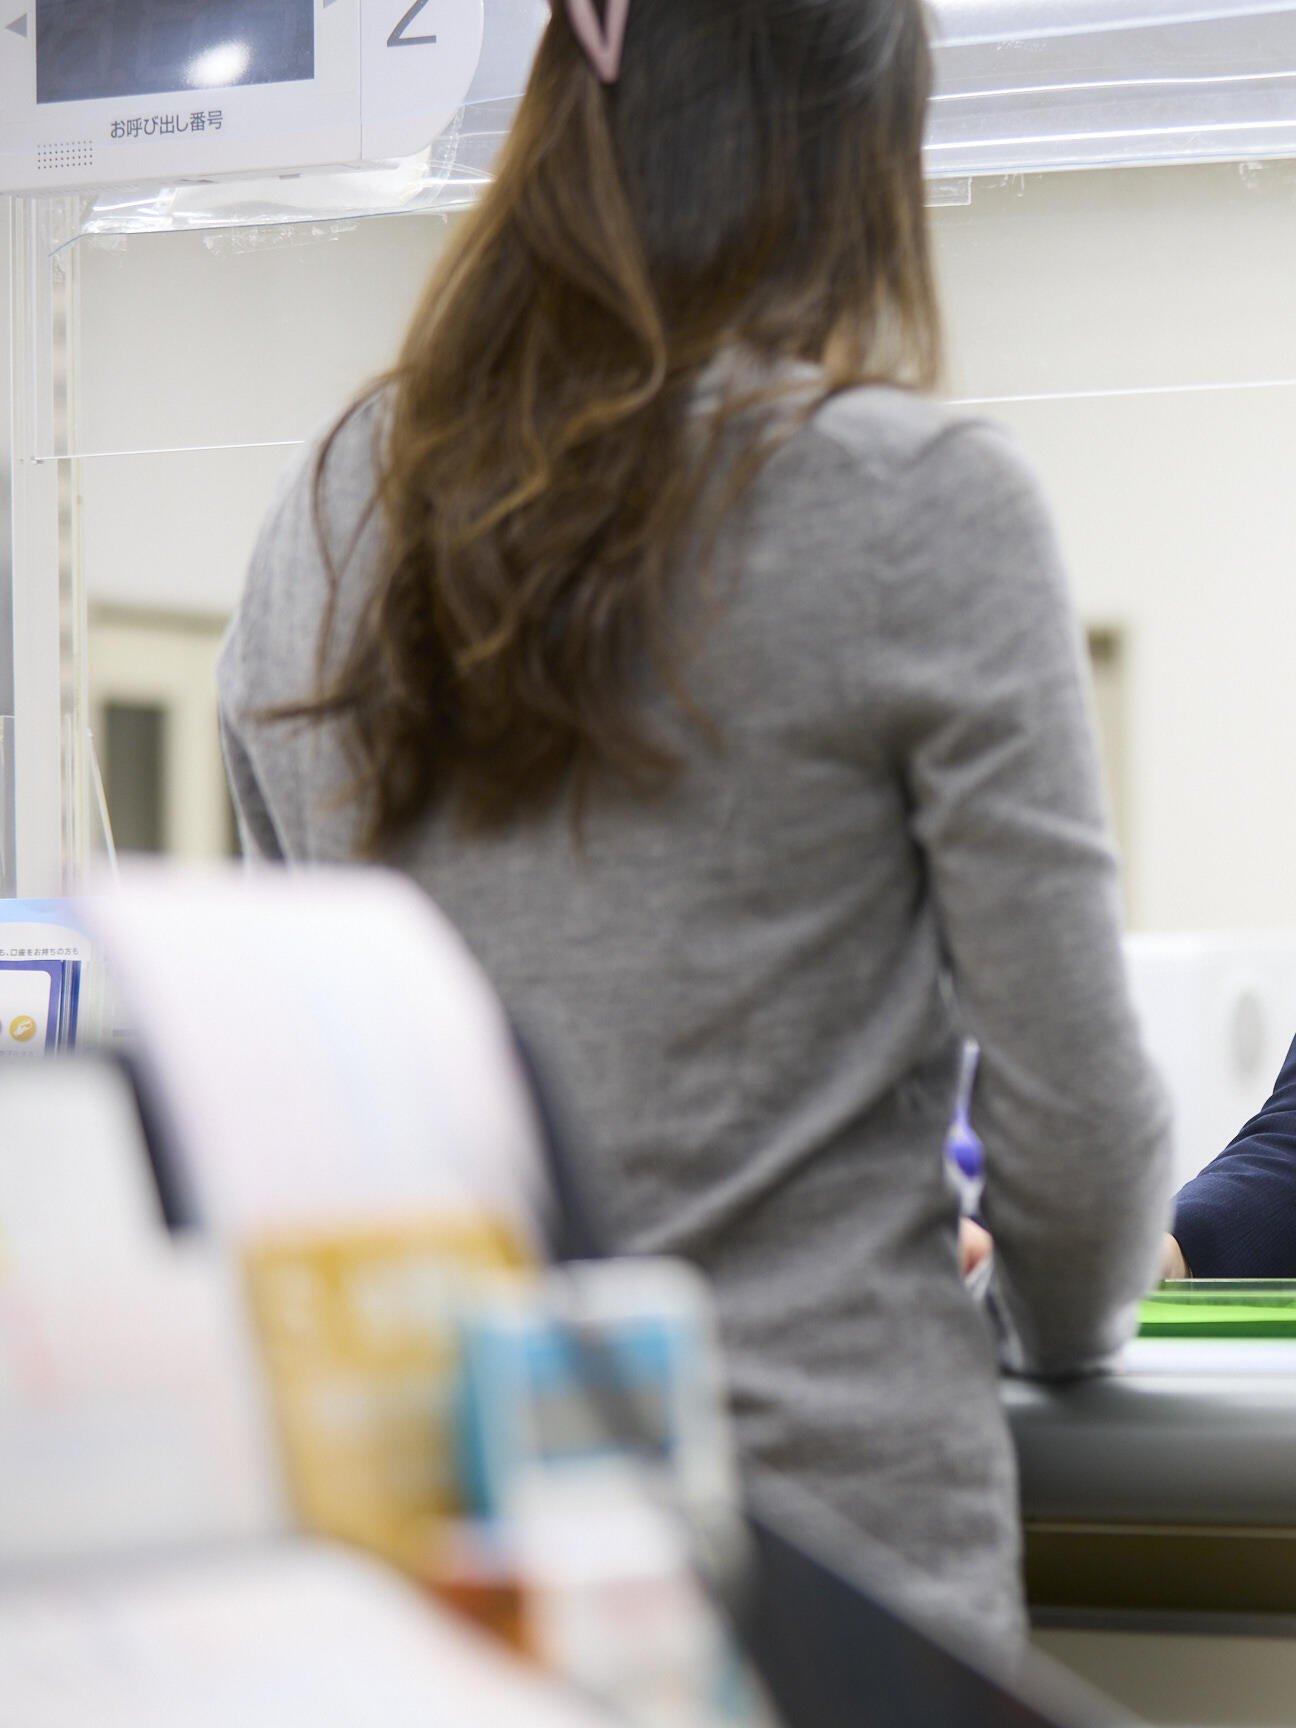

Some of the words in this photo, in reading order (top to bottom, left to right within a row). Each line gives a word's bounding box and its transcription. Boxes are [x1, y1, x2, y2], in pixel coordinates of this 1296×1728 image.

[110, 109, 224, 140] お呼び出し番号
